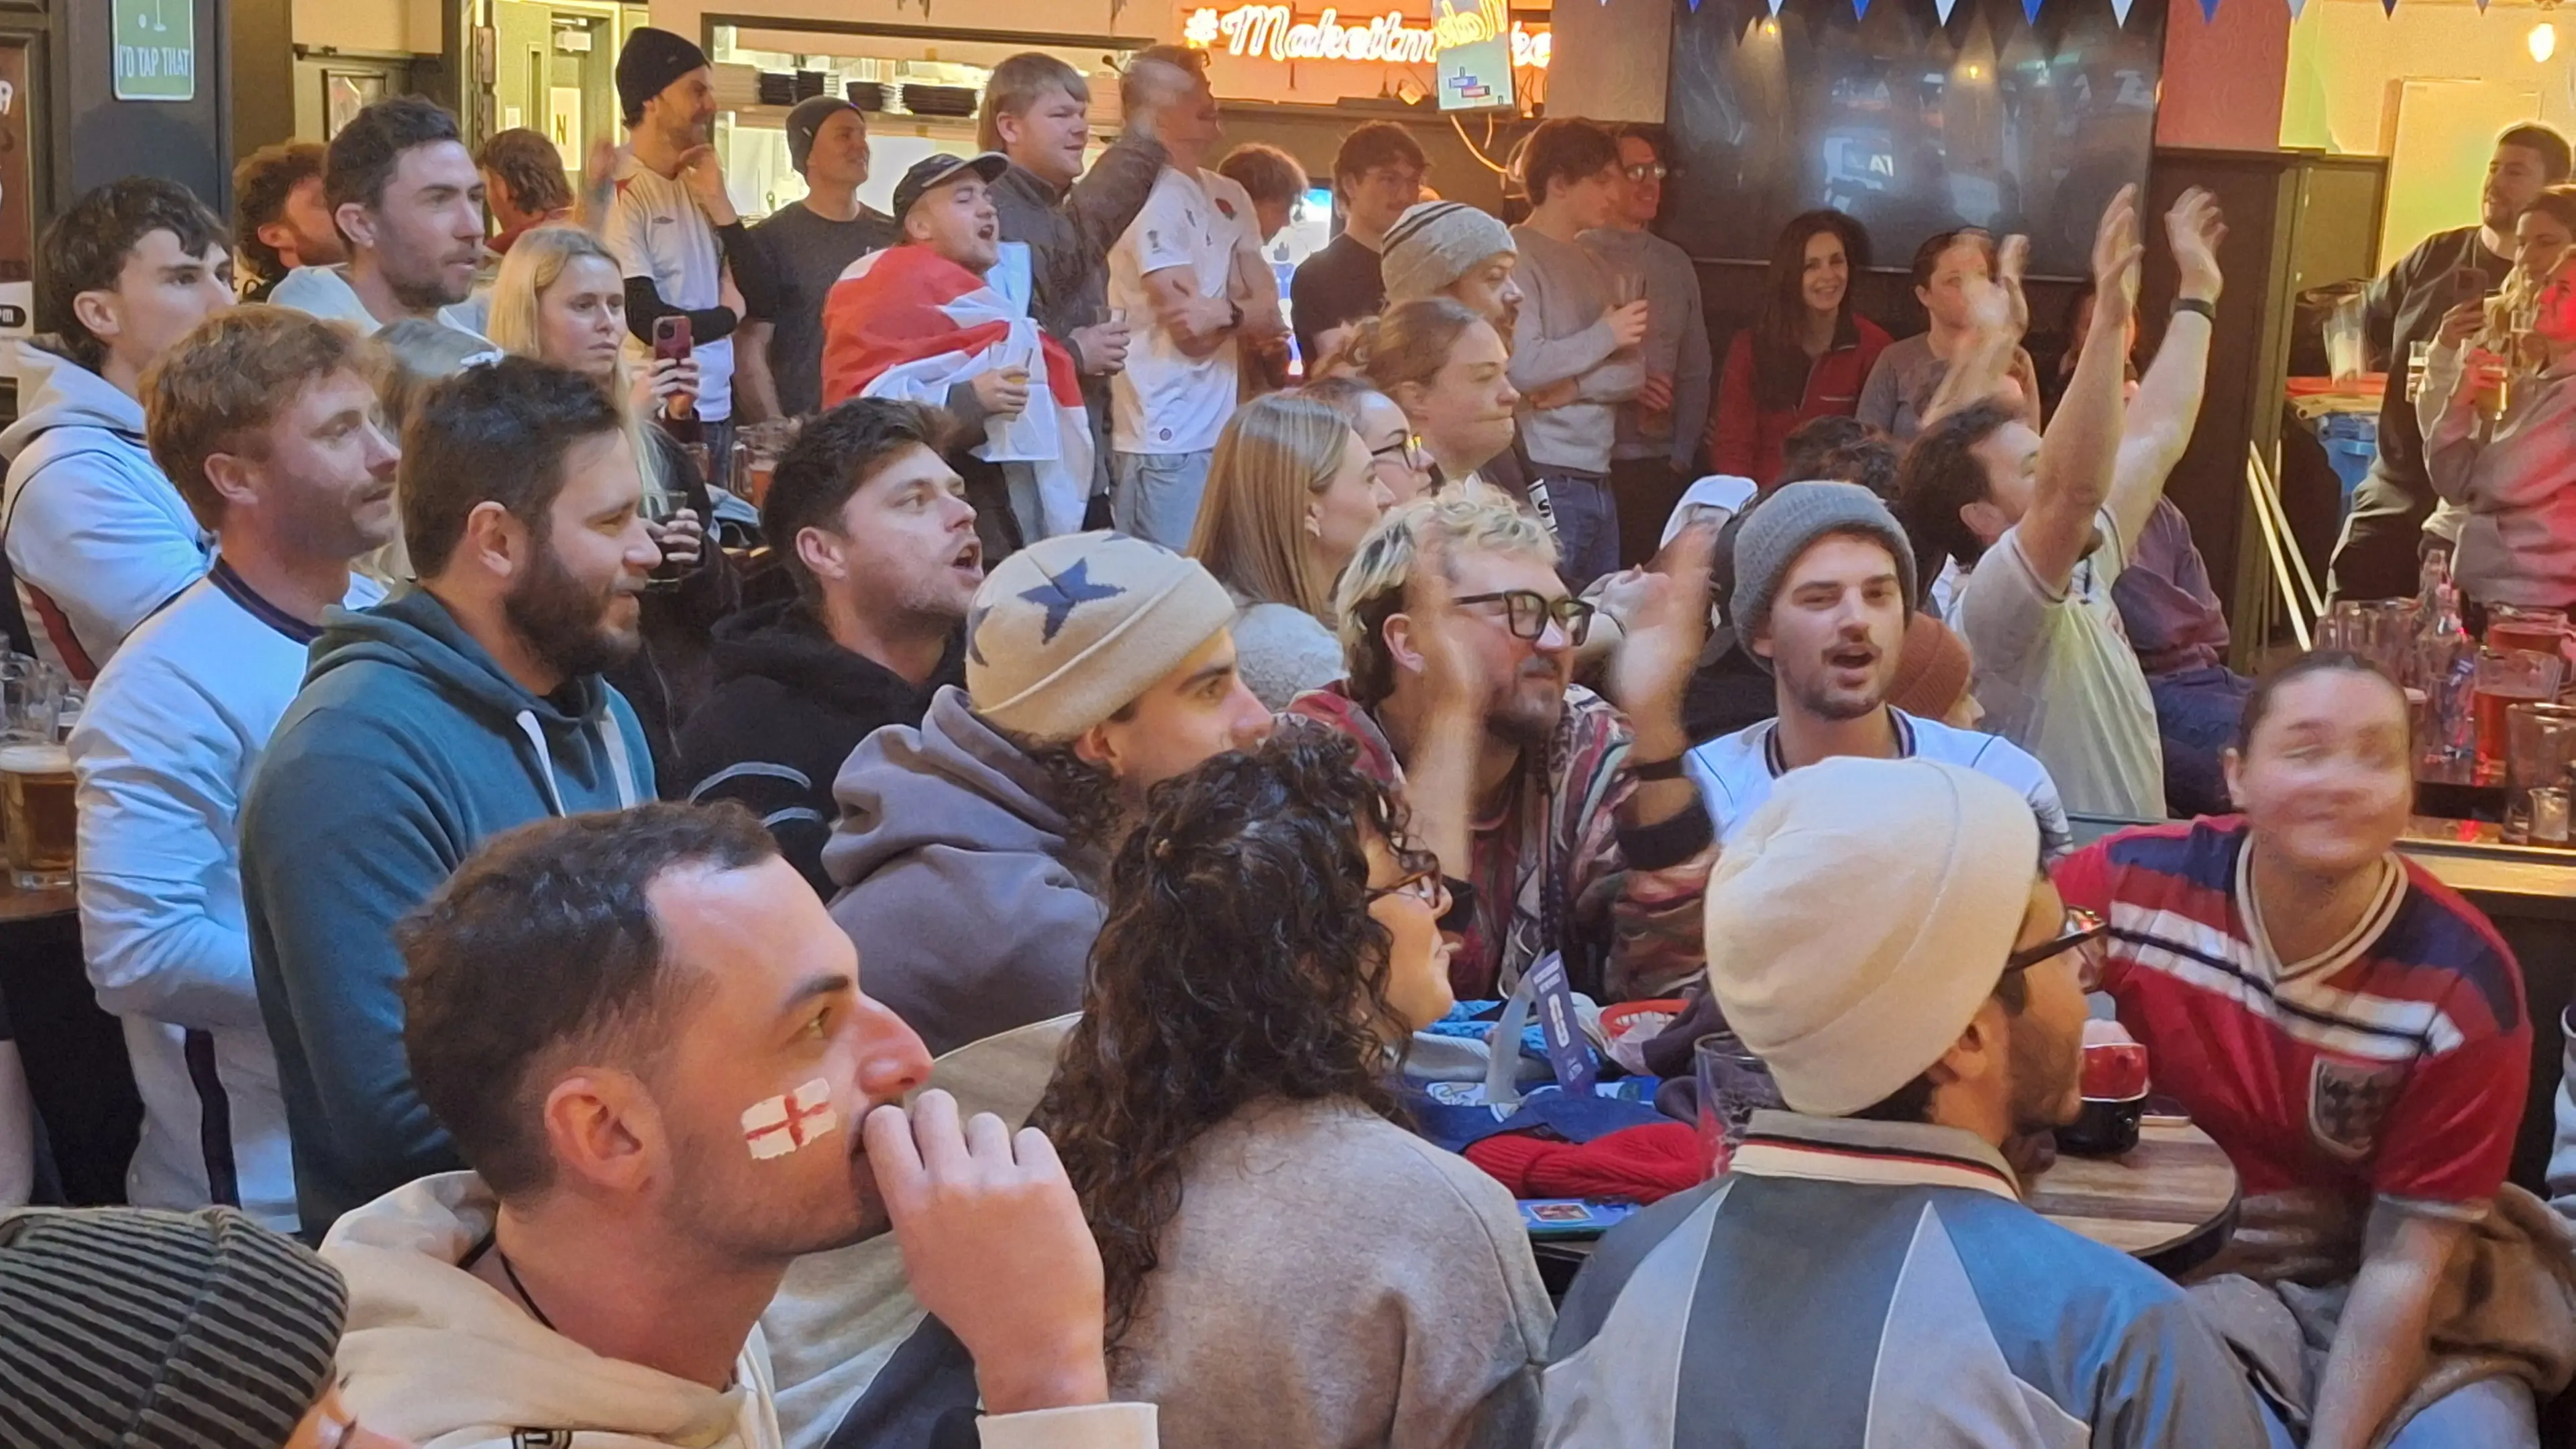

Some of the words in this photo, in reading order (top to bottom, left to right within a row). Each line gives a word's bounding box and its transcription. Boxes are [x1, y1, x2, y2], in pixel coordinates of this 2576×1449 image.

[119, 44, 134, 78] I'D
[137, 46, 159, 78] TAP
[162, 47, 190, 76] THAT
